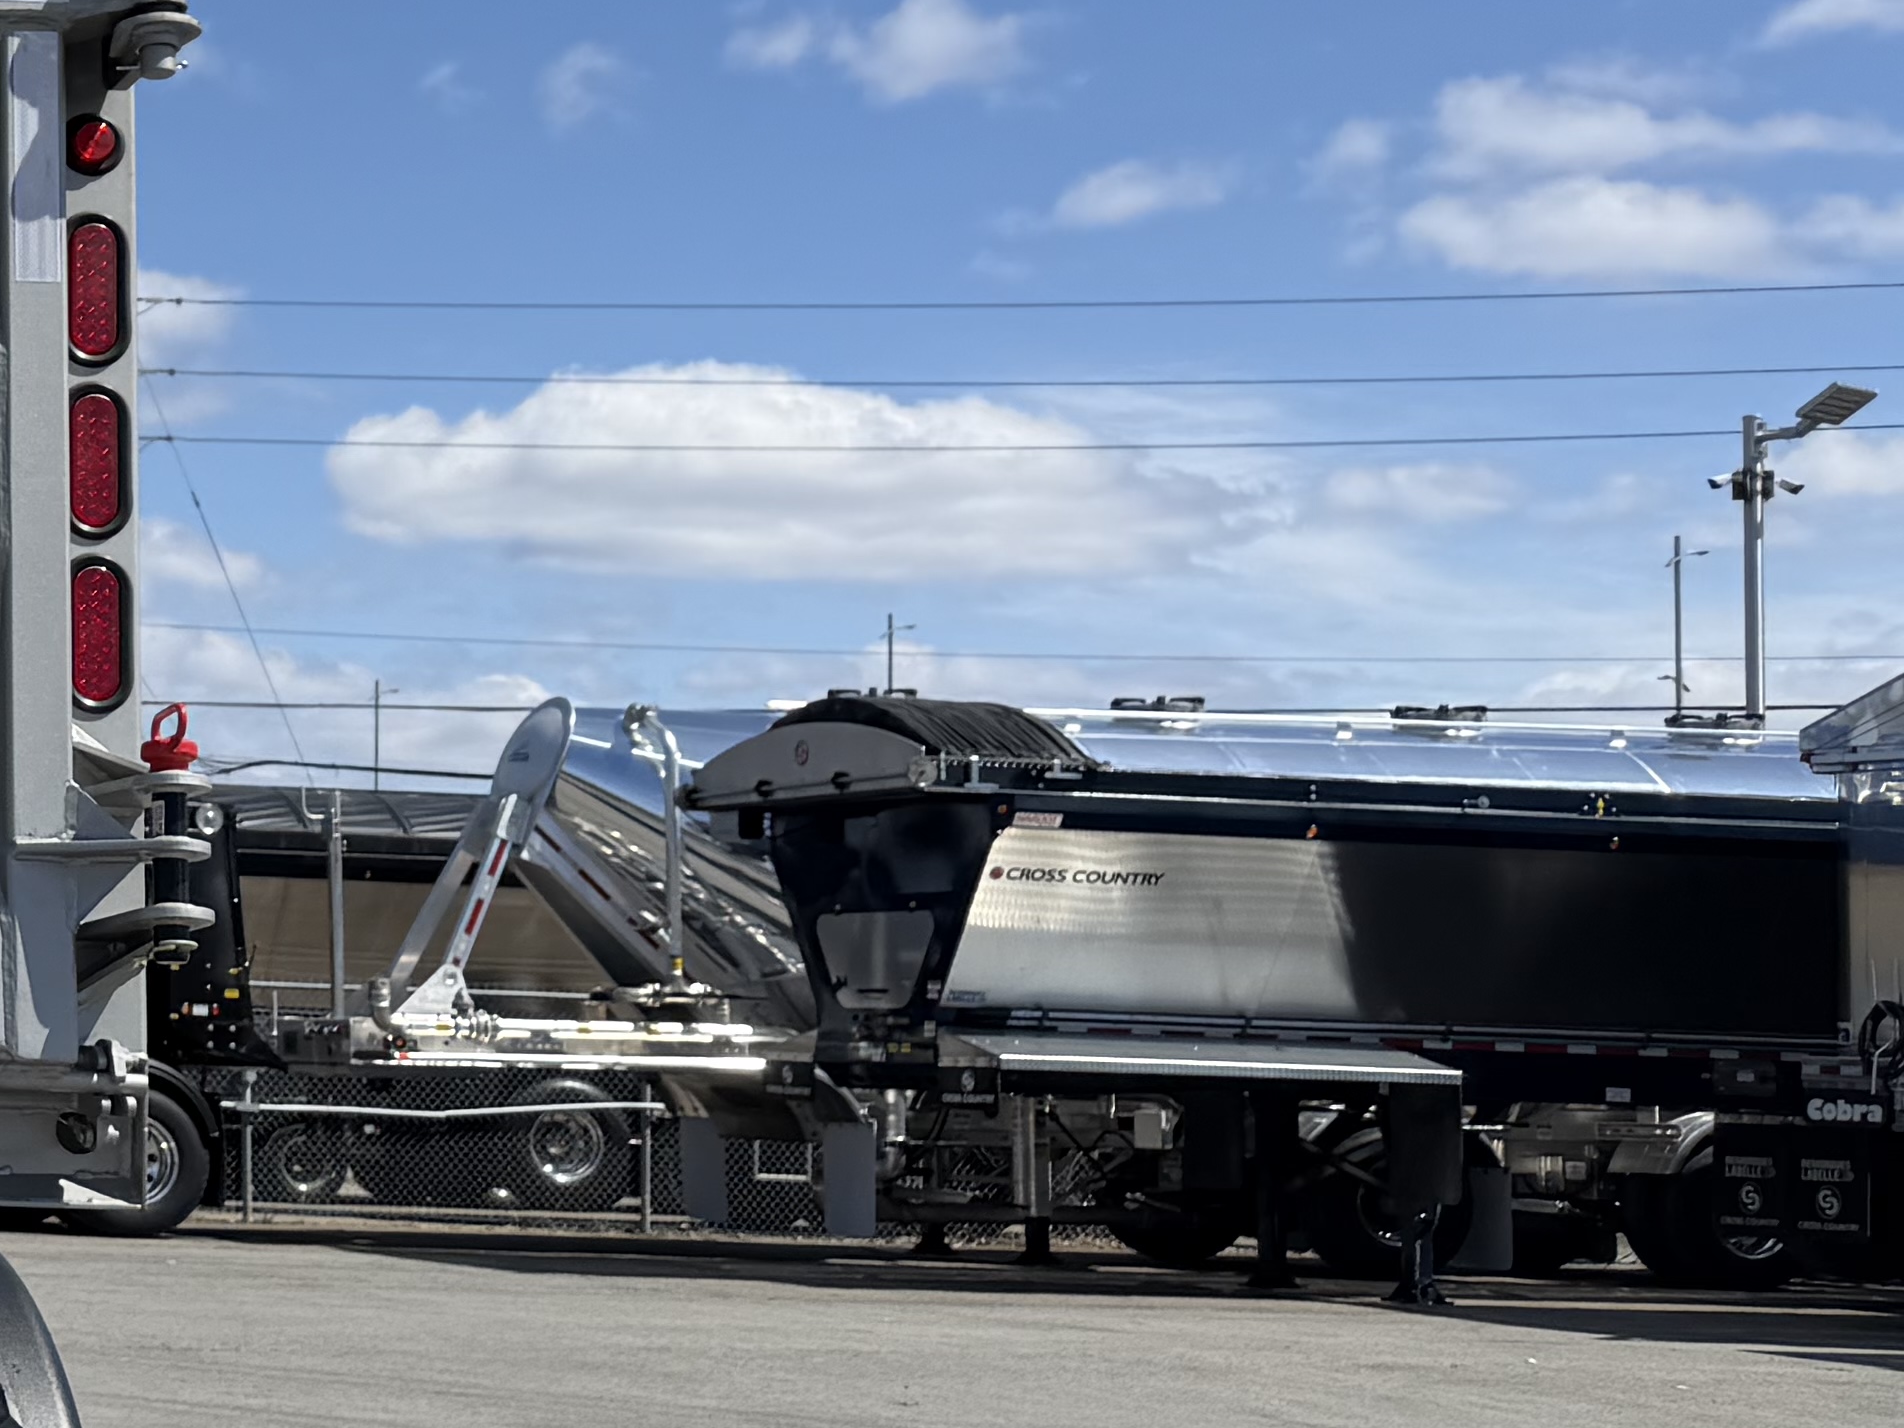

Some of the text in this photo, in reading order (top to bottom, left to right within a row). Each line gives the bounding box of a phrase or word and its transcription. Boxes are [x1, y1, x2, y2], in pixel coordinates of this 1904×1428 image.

[1006, 867, 1165, 886] CROSS COUNTRY
[1807, 1098, 1883, 1122] Cobra
